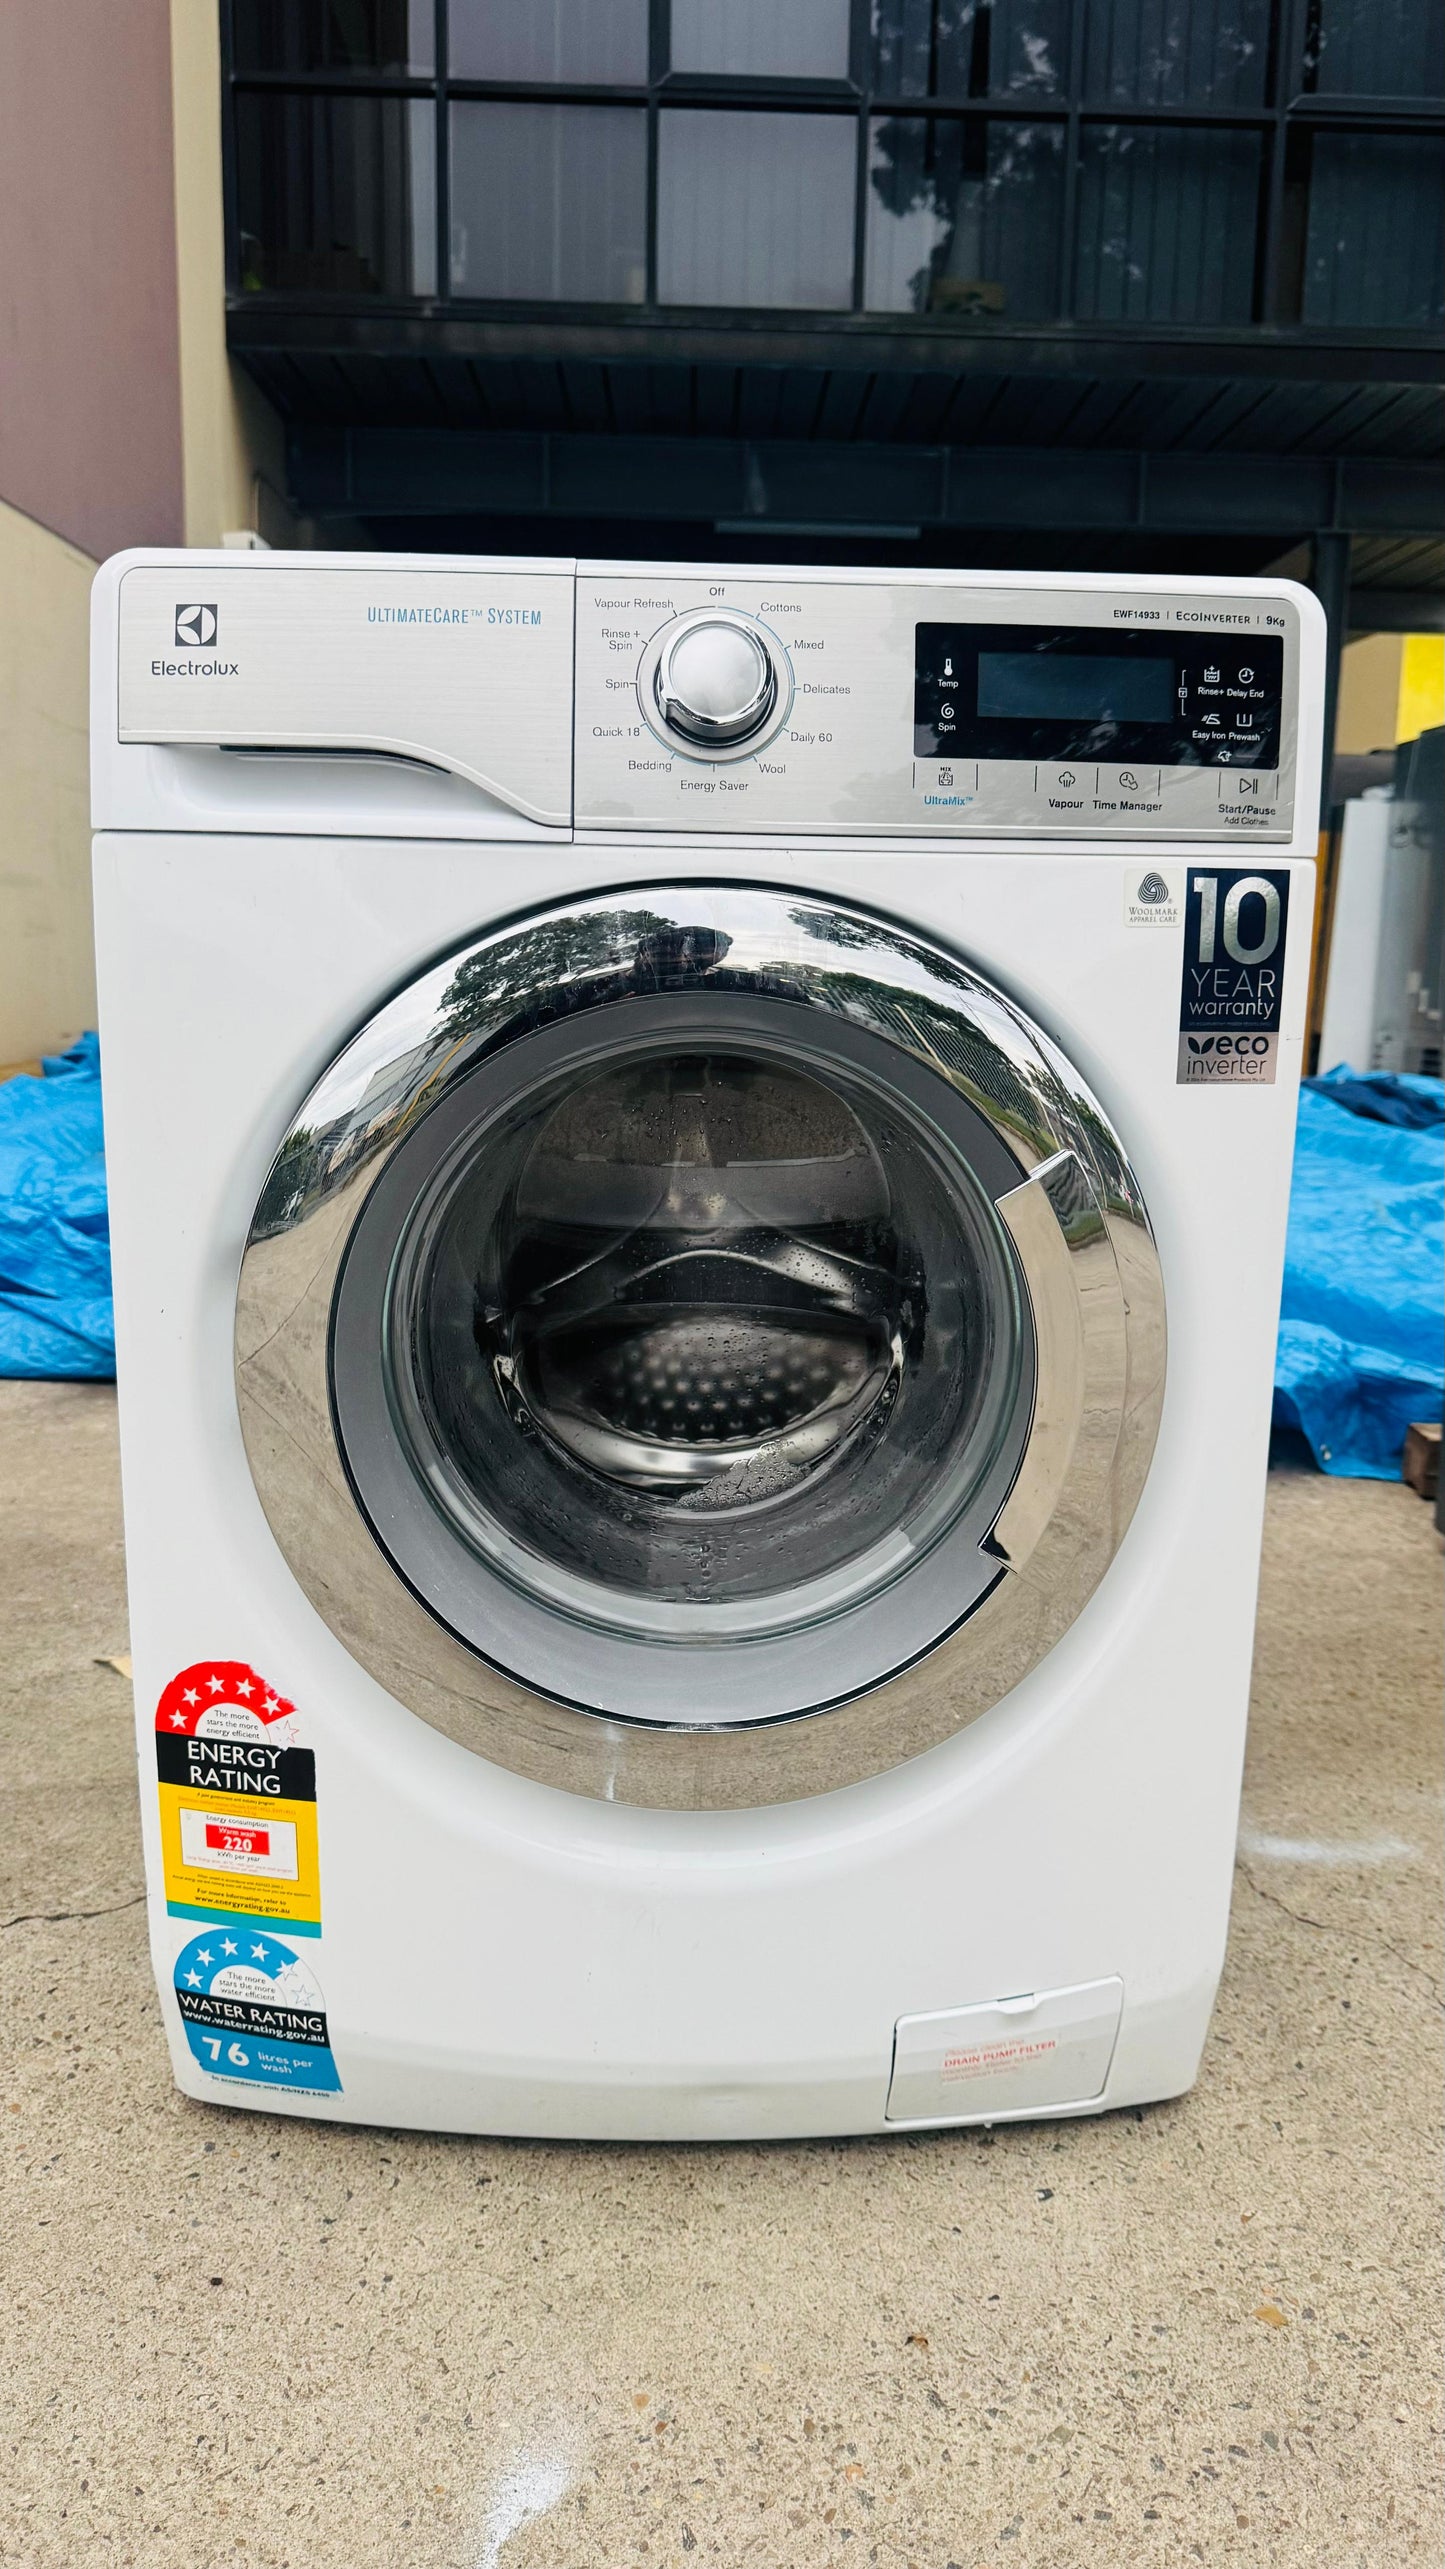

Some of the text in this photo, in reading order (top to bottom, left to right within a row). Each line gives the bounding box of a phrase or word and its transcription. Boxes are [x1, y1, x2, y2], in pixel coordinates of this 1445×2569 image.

[709, 587, 725, 596] Off
[595, 599, 674, 610] Vapour Refresh
[760, 602, 802, 612] Cottons
[1114, 610, 1160, 619] EWF14933
[602, 630, 630, 638] Rinse
[609, 640, 632, 651] Spin
[794, 640, 824, 649] Mixed
[151, 660, 239, 676] Electrolux
[606, 678, 629, 690] Spin
[803, 684, 850, 694] Delicates
[938, 679, 958, 688] Temp
[1198, 687, 1264, 699] Rinse+ Delay End
[592, 727, 640, 737] Quick 18
[938, 723, 956, 732] Spin
[791, 732, 832, 744] Daily 60
[1192, 730, 1209, 740] Easy
[1229, 732, 1260, 741] Prewash
[629, 761, 672, 772] Bedding
[760, 764, 786, 774] Wool
[681, 781, 749, 792] Energy Saver
[1049, 799, 1083, 810] Vapour
[1093, 800, 1162, 812] Time Manager
[1218, 804, 1276, 815] Start/Pause
[1241, 817, 1269, 825] Clothes
[1194, 876, 1280, 964] 10
[1191, 969, 1276, 998] YEAR
[1189, 998, 1274, 1020] warranty
[1216, 1036, 1269, 1055] eco
[1187, 1056, 1267, 1074] inverter
[214, 1710, 228, 1718] The
[226, 1720, 237, 1729] the
[206, 1728, 260, 1740] energy efficient
[188, 1741, 281, 1769] ENERGY
[190, 1766, 281, 1794] RATING
[206, 1815, 268, 1828] Energy consumption
[219, 1827, 238, 1836] Warm
[223, 1836, 253, 1852] 220
[194, 1896, 290, 1914] www.energyrating.gov.au
[227, 1971, 266, 1984] The more
[219, 1980, 276, 1994] stars the more
[221, 1988, 276, 2002] water efficient
[179, 1994, 323, 2032] WATER RATING
[183, 2010, 325, 2043] www.waterrating.gov.au
[202, 2036, 250, 2067] 76
[944, 2056, 980, 2067] DRAIN
[984, 2049, 1016, 2060] PUMP
[1020, 2041, 1056, 2054] FILTER
[258, 2052, 313, 2068] litres per
[261, 2063, 292, 2074] wash
